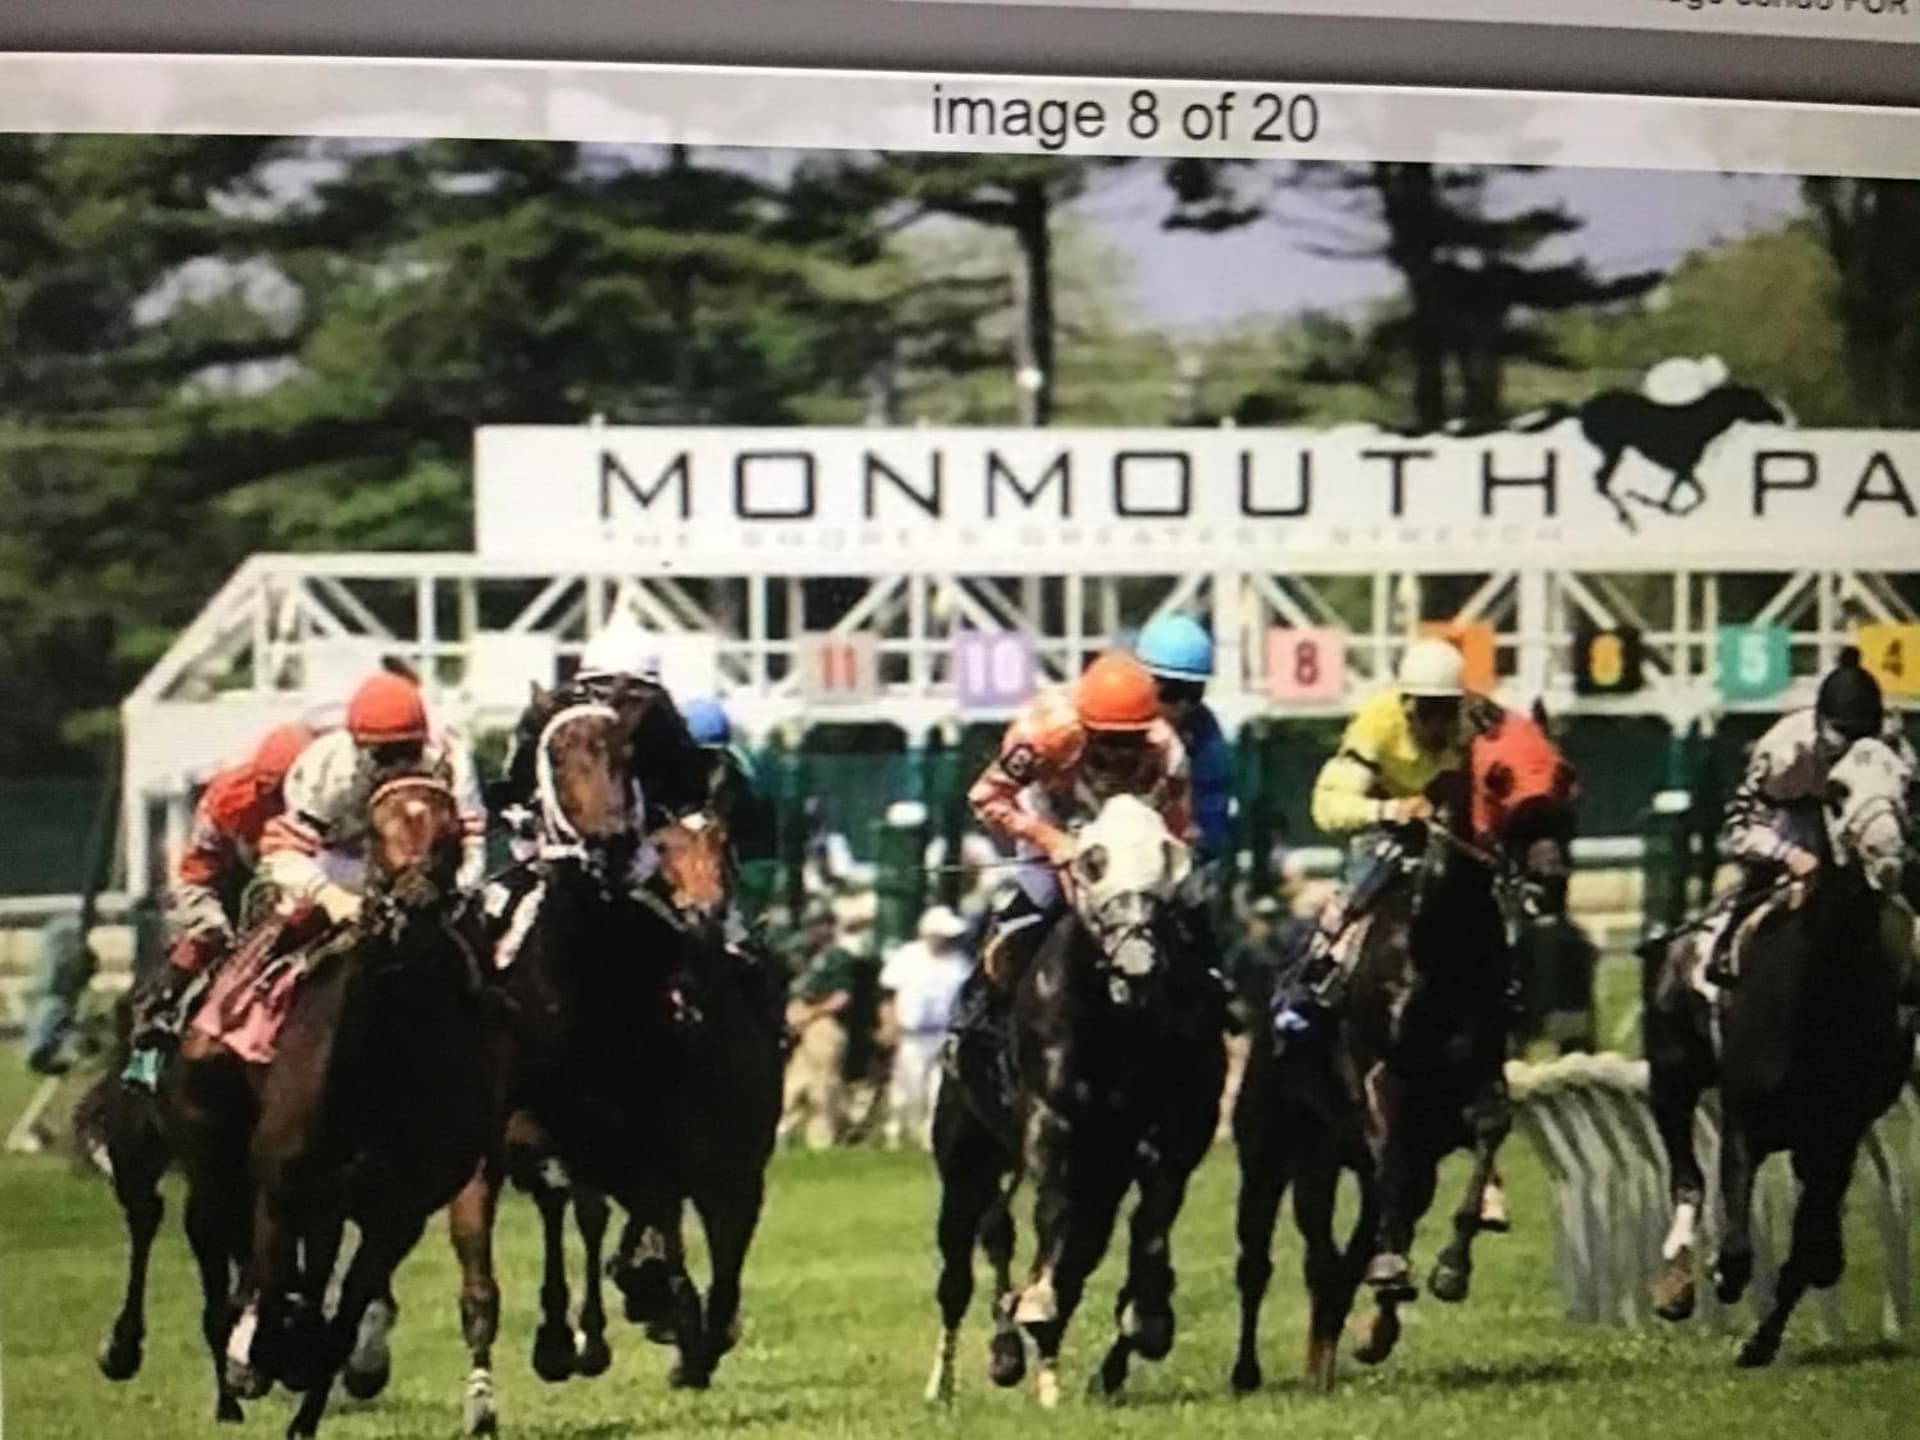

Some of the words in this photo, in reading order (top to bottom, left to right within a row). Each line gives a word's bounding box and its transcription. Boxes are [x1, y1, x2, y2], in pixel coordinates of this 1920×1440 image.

[932, 84, 1107, 151] image
[1129, 89, 1159, 139] 8
[1182, 91, 1236, 141] of
[1252, 93, 1319, 143] 20
[598, 449, 1557, 520] MONMOUTH
[1753, 449, 1919, 518] PA
[822, 643, 857, 692] 11
[966, 639, 1024, 694] 10
[1295, 640, 1319, 686] 8
[1882, 638, 1904, 678] 4
